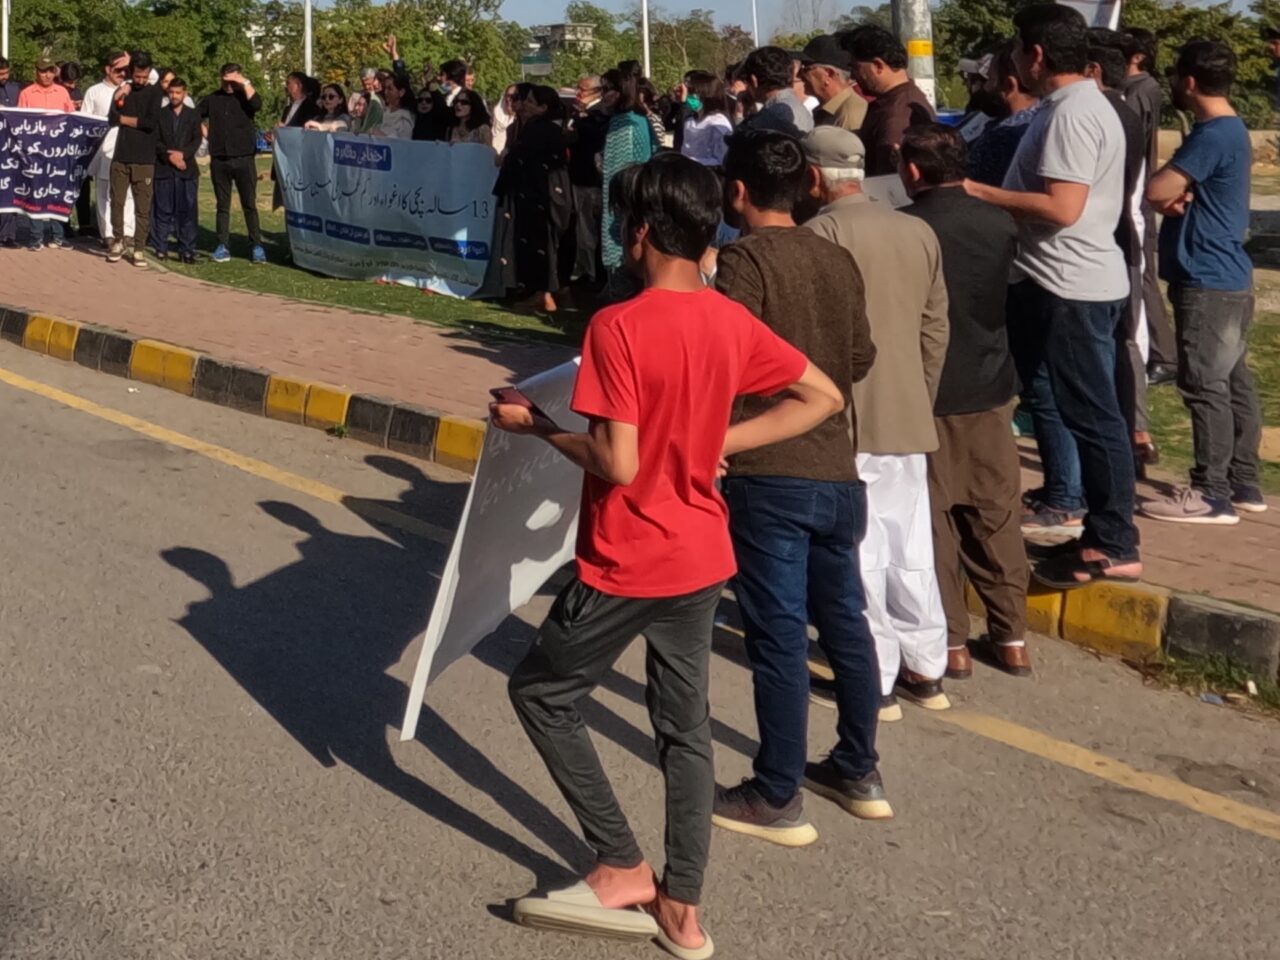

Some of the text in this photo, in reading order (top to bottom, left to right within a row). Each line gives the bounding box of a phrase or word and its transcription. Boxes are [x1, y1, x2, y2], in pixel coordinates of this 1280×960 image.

[11, 119, 46, 136] بازیابی
[50, 121, 67, 138] کی
[27, 141, 41, 155] کو
[1, 157, 20, 170] تک
[46, 163, 67, 178] سزا
[33, 183, 60, 199] جاری
[409, 187, 424, 219] بچی
[426, 195, 471, 214] سالہ
[472, 200, 489, 219] 13
